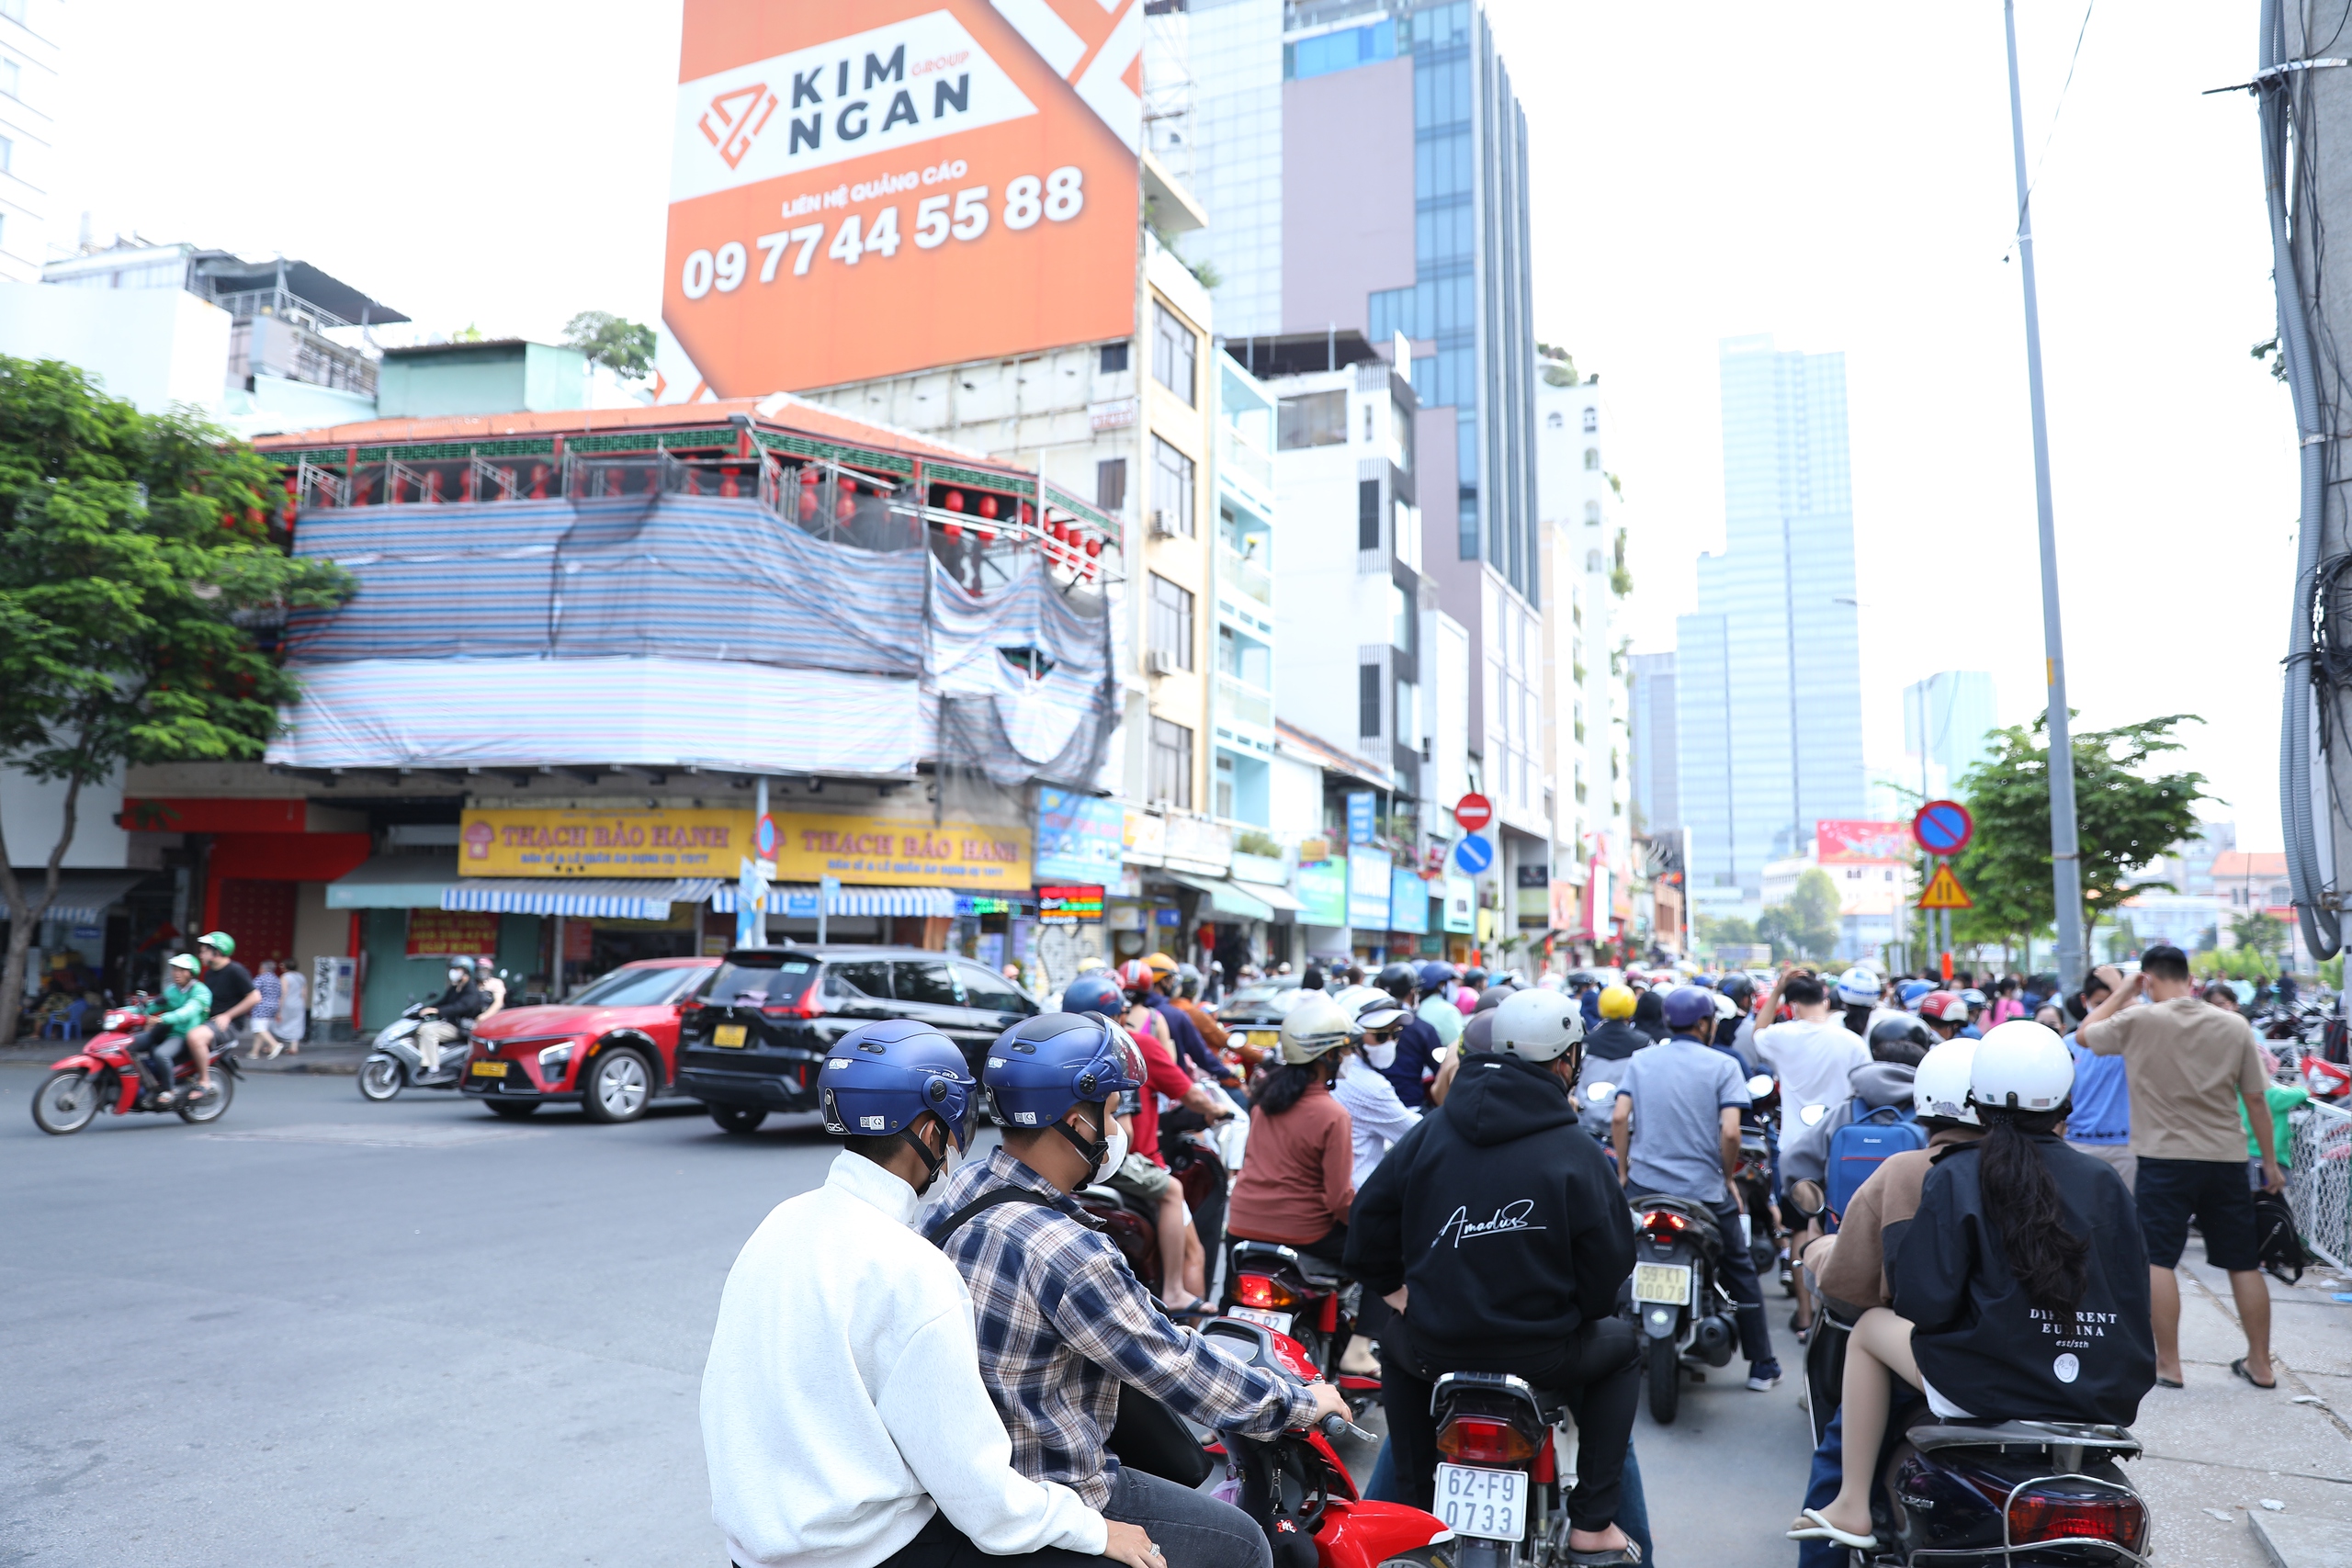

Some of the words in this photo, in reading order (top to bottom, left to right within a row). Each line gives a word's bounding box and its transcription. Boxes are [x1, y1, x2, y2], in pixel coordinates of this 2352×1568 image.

[792, 44, 905, 108] KIM
[912, 51, 969, 76] GROUP
[789, 73, 970, 154] NGAN
[781, 193, 821, 218] LIÊN
[823, 184, 849, 209] HỆ
[922, 159, 967, 186] CÁO
[681, 241, 747, 299] 09
[756, 221, 823, 283] 77
[829, 206, 900, 265] 44
[913, 186, 989, 249] 55
[1003, 165, 1083, 231] 88
[501, 826, 586, 851] THẠCH
[593, 819, 644, 847] BẢO
[651, 826, 729, 851] HẠNH
[903, 832, 953, 859] BẢO
[1449, 1469, 1514, 1502] 62-F9
[1445, 1501, 1512, 1533] 0733
